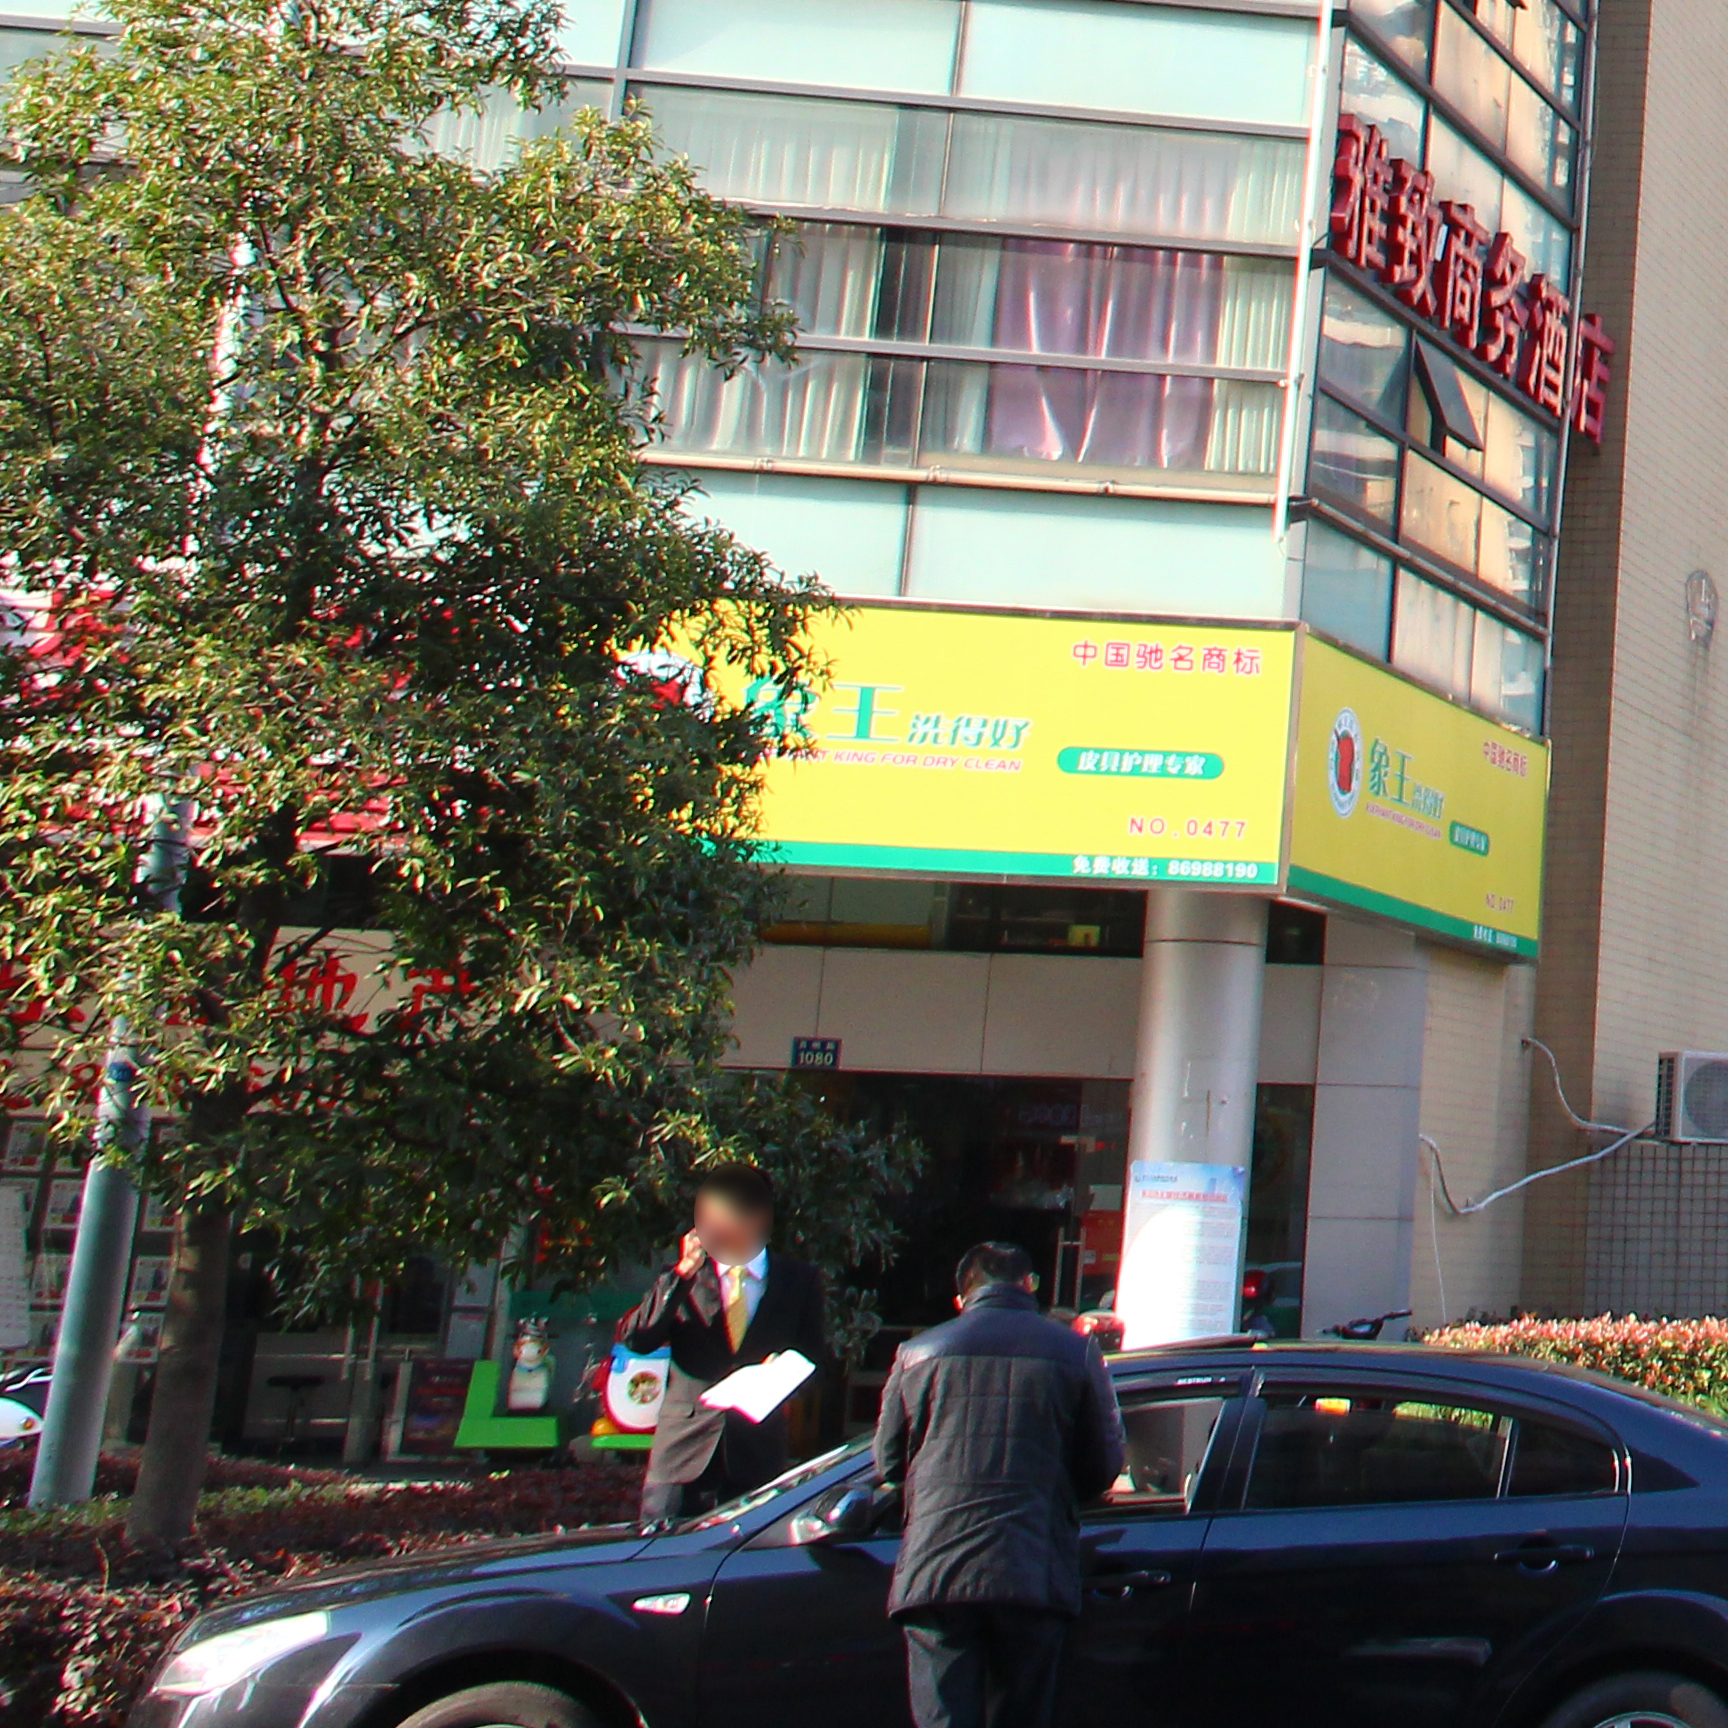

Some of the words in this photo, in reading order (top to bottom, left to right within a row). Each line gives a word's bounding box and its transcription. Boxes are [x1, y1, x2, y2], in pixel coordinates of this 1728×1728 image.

[1330, 113, 1616, 452] 雅致商务酒店
[1073, 640, 1260, 674] 中国驰名商标
[907, 713, 1031, 749] 洗得好
[834, 751, 876, 764] KING
[880, 753, 918, 766] FOR
[922, 755, 959, 768] DRY
[963, 757, 1021, 771] CLEAN
[800, 1051, 834, 1065] 1080
